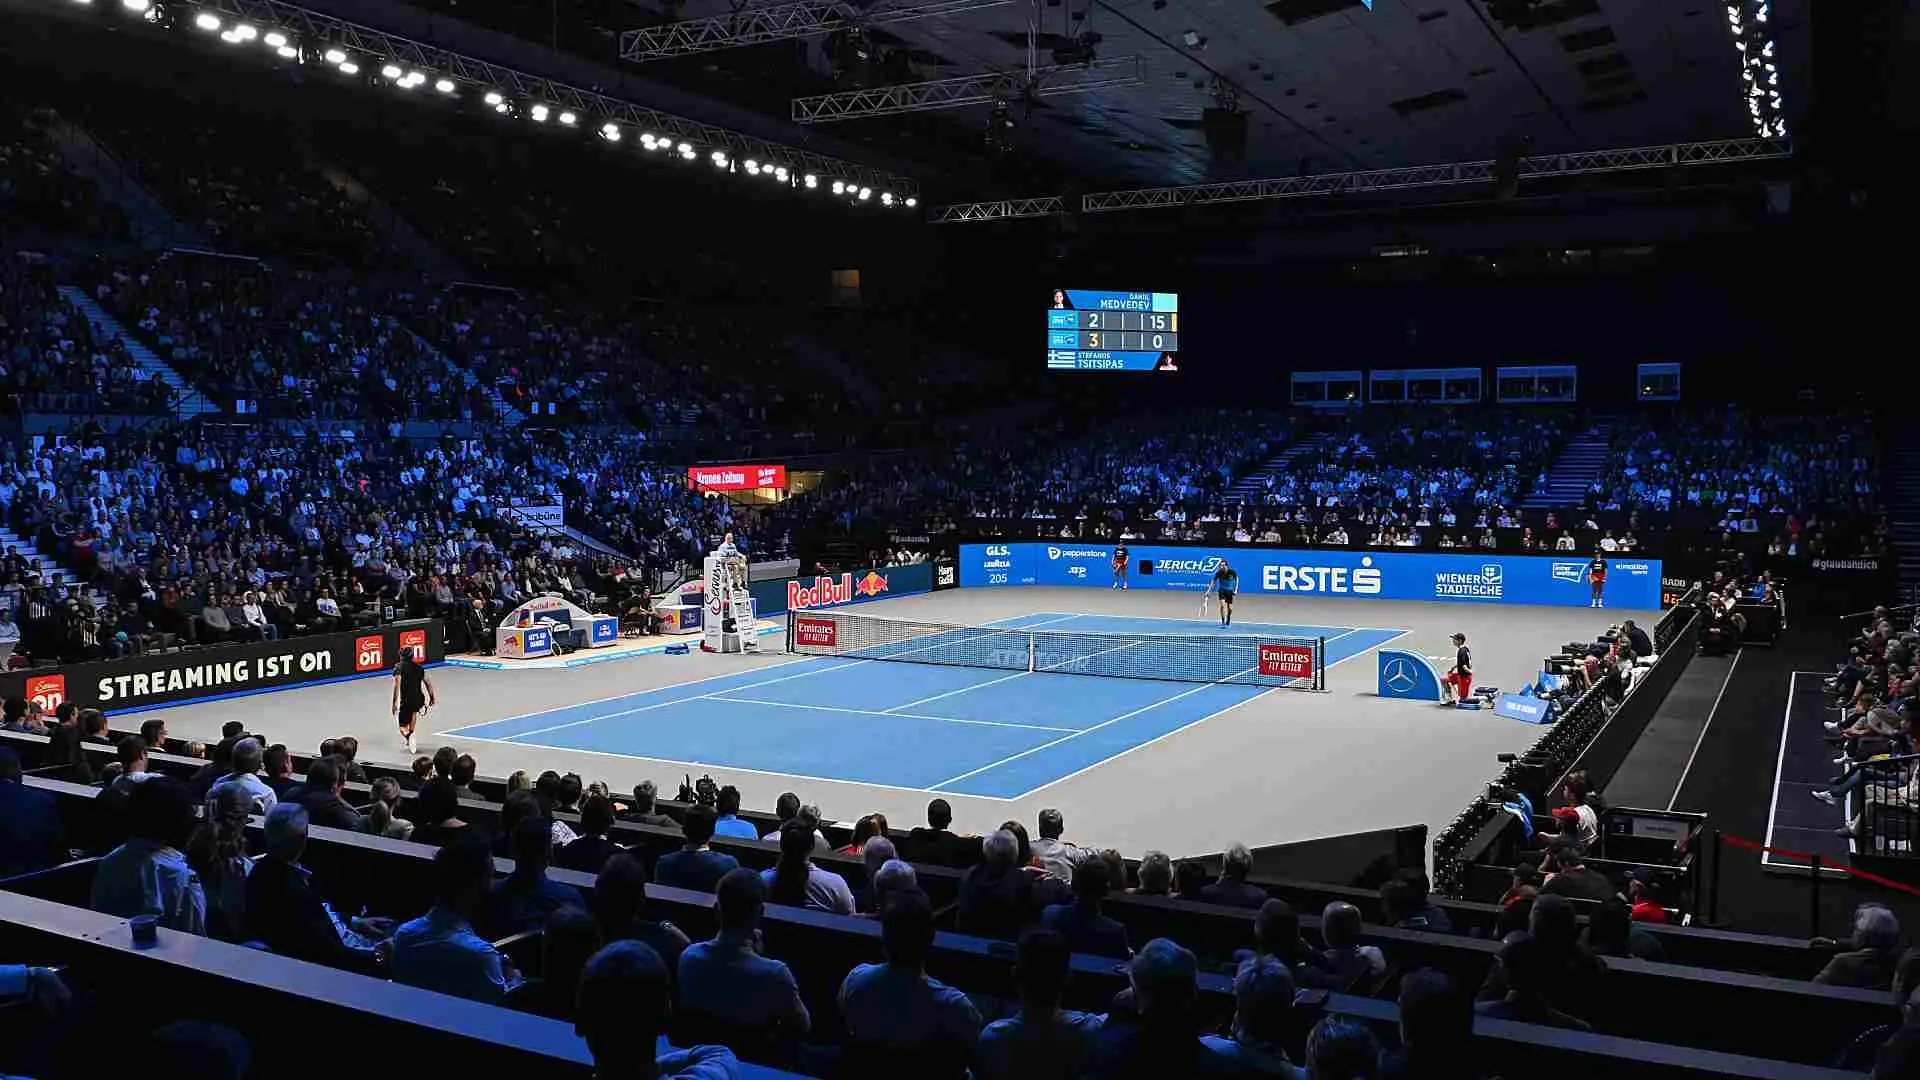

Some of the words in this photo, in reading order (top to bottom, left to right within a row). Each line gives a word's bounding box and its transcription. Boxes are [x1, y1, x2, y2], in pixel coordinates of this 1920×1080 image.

[1101, 300, 1150, 309] MEDVEDEV
[1088, 313, 1099, 328] 2
[1150, 315, 1165, 329] 15
[1088, 333, 1099, 347] 3
[1152, 335, 1163, 349] 0
[1079, 360, 1124, 369] TSITSIPAS
[1062, 550, 1106, 559] pepperstone
[1156, 560, 1201, 569] JERICH
[988, 574, 1008, 583] 205
[1263, 565, 1347, 592] ERSTE
[1435, 573, 1481, 585] WIENER
[1662, 578, 1686, 587] RADO
[787, 575, 820, 609] Red
[821, 573, 852, 605] Bull
[1435, 583, 1503, 596] STÄDTISCHE
[799, 622, 833, 635] Emirates
[359, 650, 381, 666] on
[1262, 649, 1310, 663] Emirates
[1280, 662, 1302, 672] BETTER
[98, 661, 249, 701] STREAMING
[257, 654, 294, 679] IST
[299, 650, 331, 672] on
